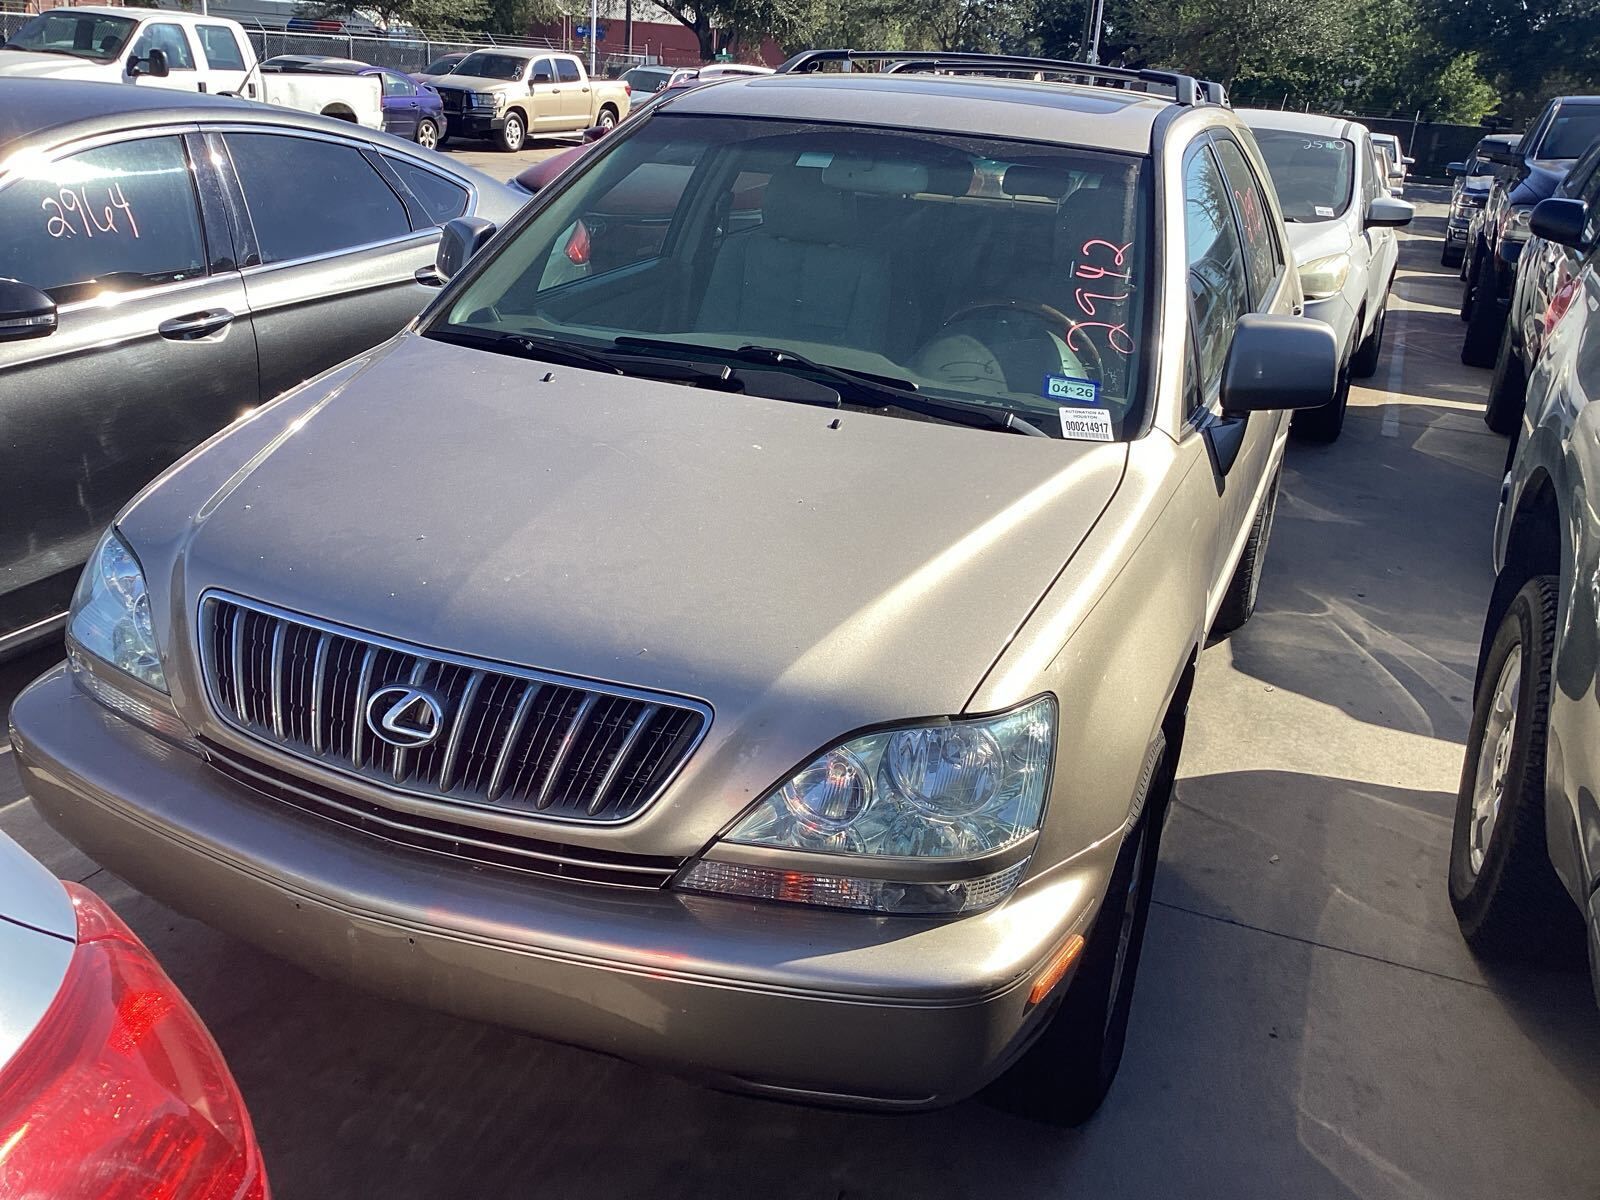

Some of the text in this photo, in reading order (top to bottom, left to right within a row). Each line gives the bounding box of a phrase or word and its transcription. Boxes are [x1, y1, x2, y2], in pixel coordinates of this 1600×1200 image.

[42, 182, 139, 238] 2964
[1066, 239, 1136, 354] 2942
[1052, 384, 1069, 394] 04
[1076, 387, 1093, 397] 26
[1065, 421, 1108, 433] 000214917
